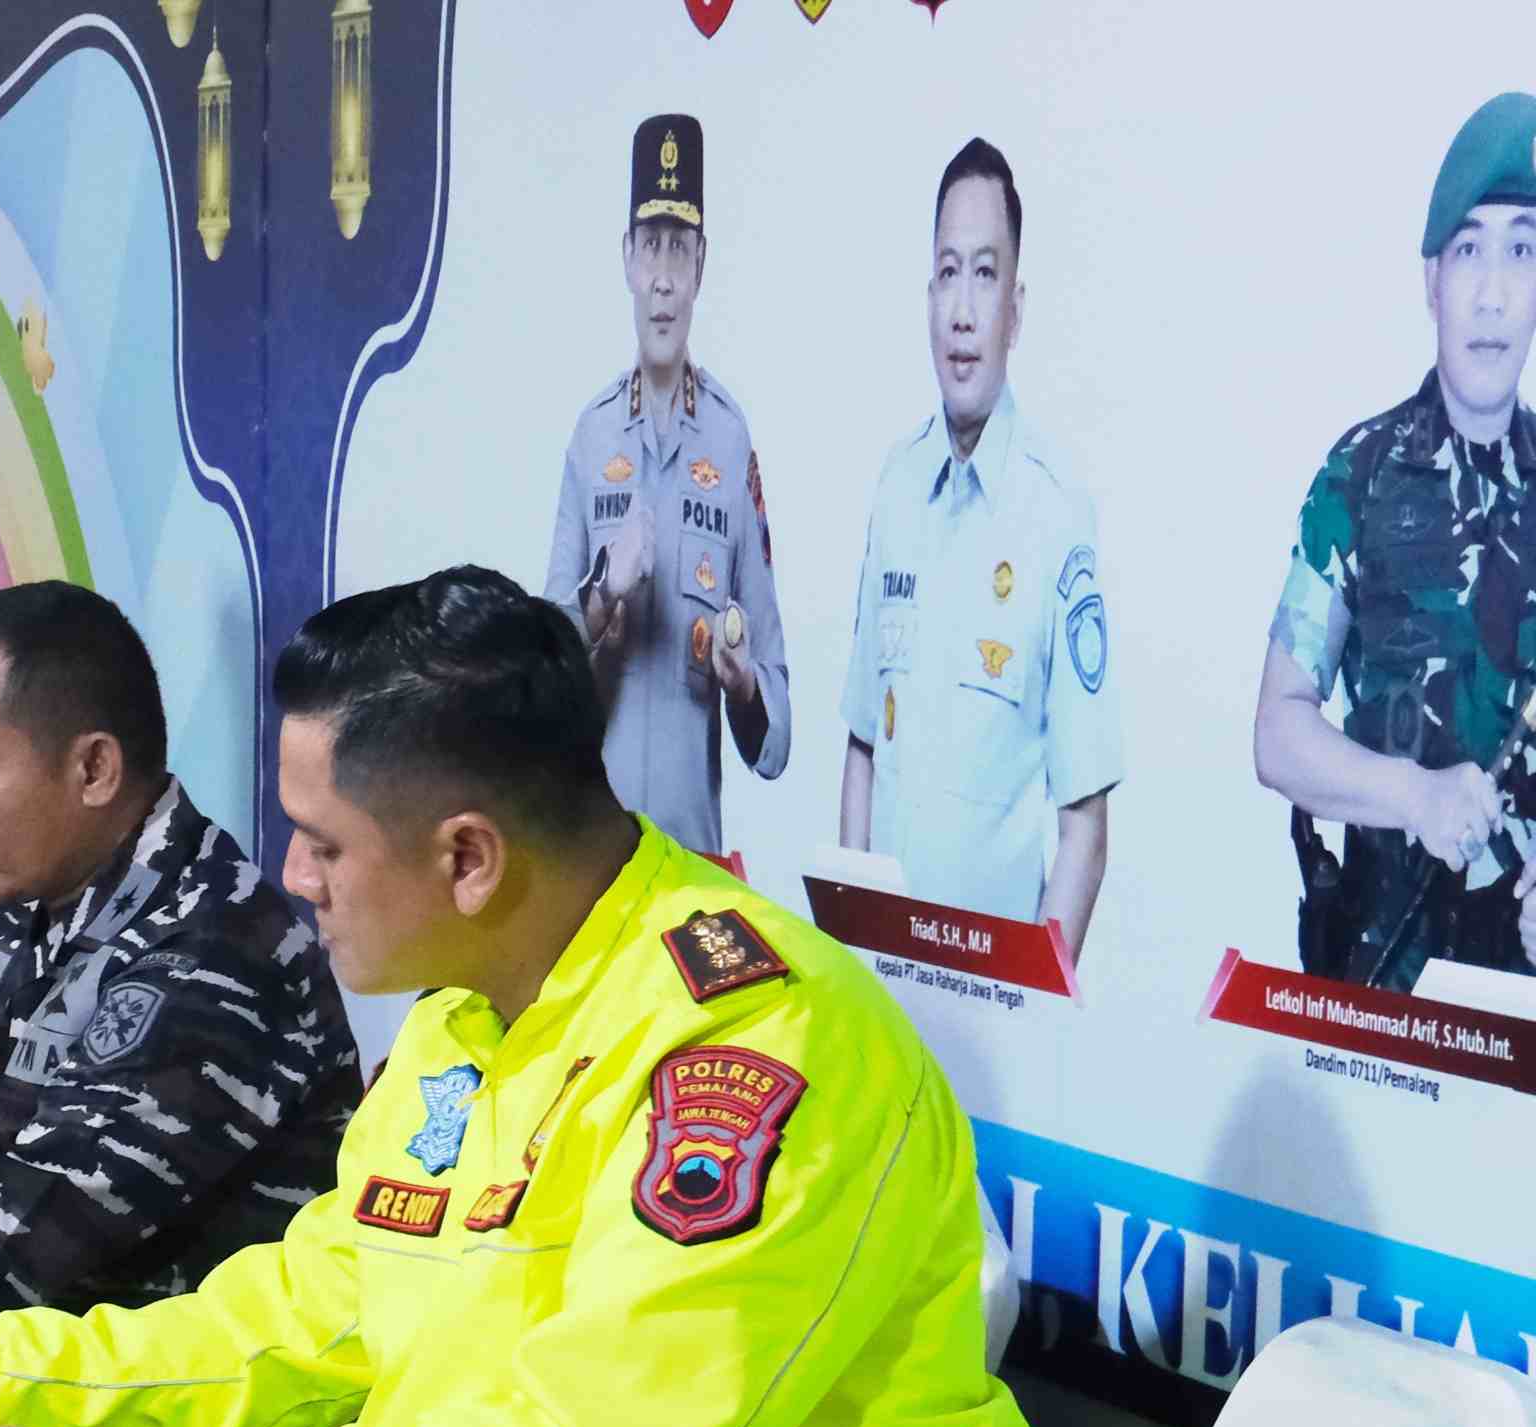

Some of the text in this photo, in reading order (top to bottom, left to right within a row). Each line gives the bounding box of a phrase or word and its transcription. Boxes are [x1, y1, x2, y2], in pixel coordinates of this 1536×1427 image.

[682, 498, 728, 538] POLRI
[883, 571, 917, 600] TRIADI
[909, 916, 940, 947] Triadi,
[968, 929, 992, 955] M.H
[875, 956, 1025, 1010] Kepala PT Jasa Raharja Jawa Tengah
[1265, 986, 1304, 1016] Letkol
[1306, 995, 1324, 1018] Inf
[1327, 999, 1409, 1038] Muhammad
[1411, 1016, 1440, 1049] Arif,
[675, 1060, 775, 1094] POLRES
[678, 1082, 763, 1107] PEMALANG
[1305, 1048, 1441, 1102] Dandim 0711/Pemalang
[677, 1107, 752, 1131] JAWA TENGAH
